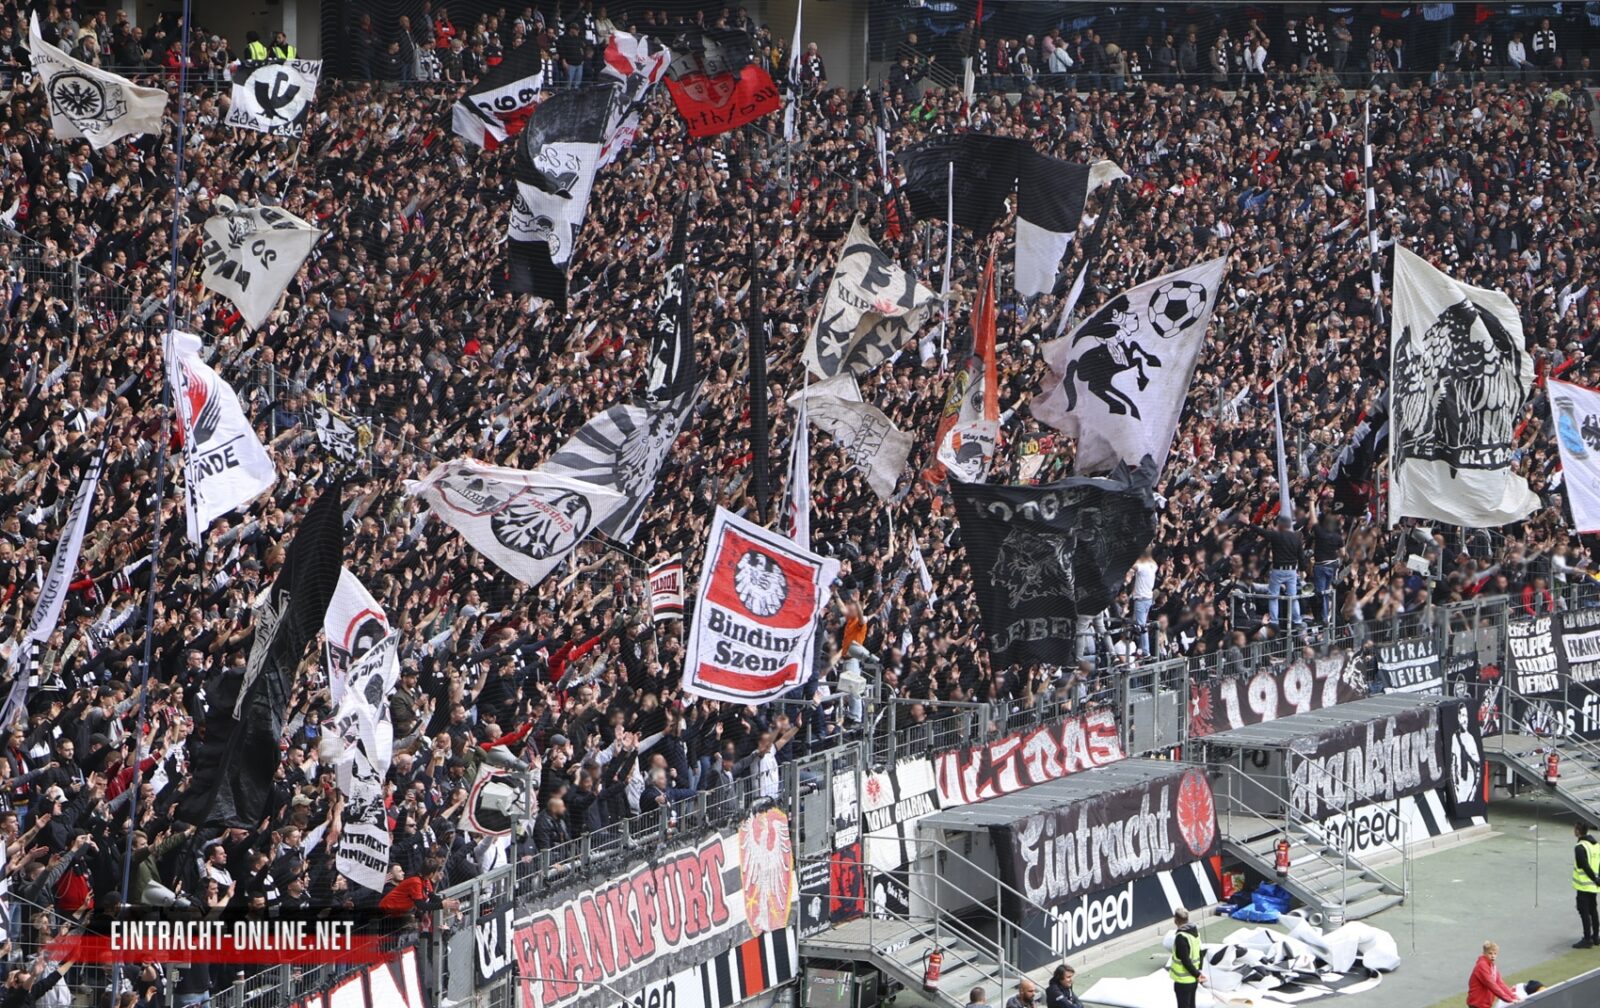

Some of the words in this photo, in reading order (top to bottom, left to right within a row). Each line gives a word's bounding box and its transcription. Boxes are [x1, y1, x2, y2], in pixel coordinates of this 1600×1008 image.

[1380, 640, 1433, 663] ULTRAS
[1388, 665, 1434, 688] NEVER
[1219, 655, 1345, 730] 1997
[934, 709, 1126, 810] ULTRAS
[1018, 784, 1176, 902] Eintracht
[514, 837, 729, 1008] FRANKFURT
[1049, 880, 1134, 957] indeed
